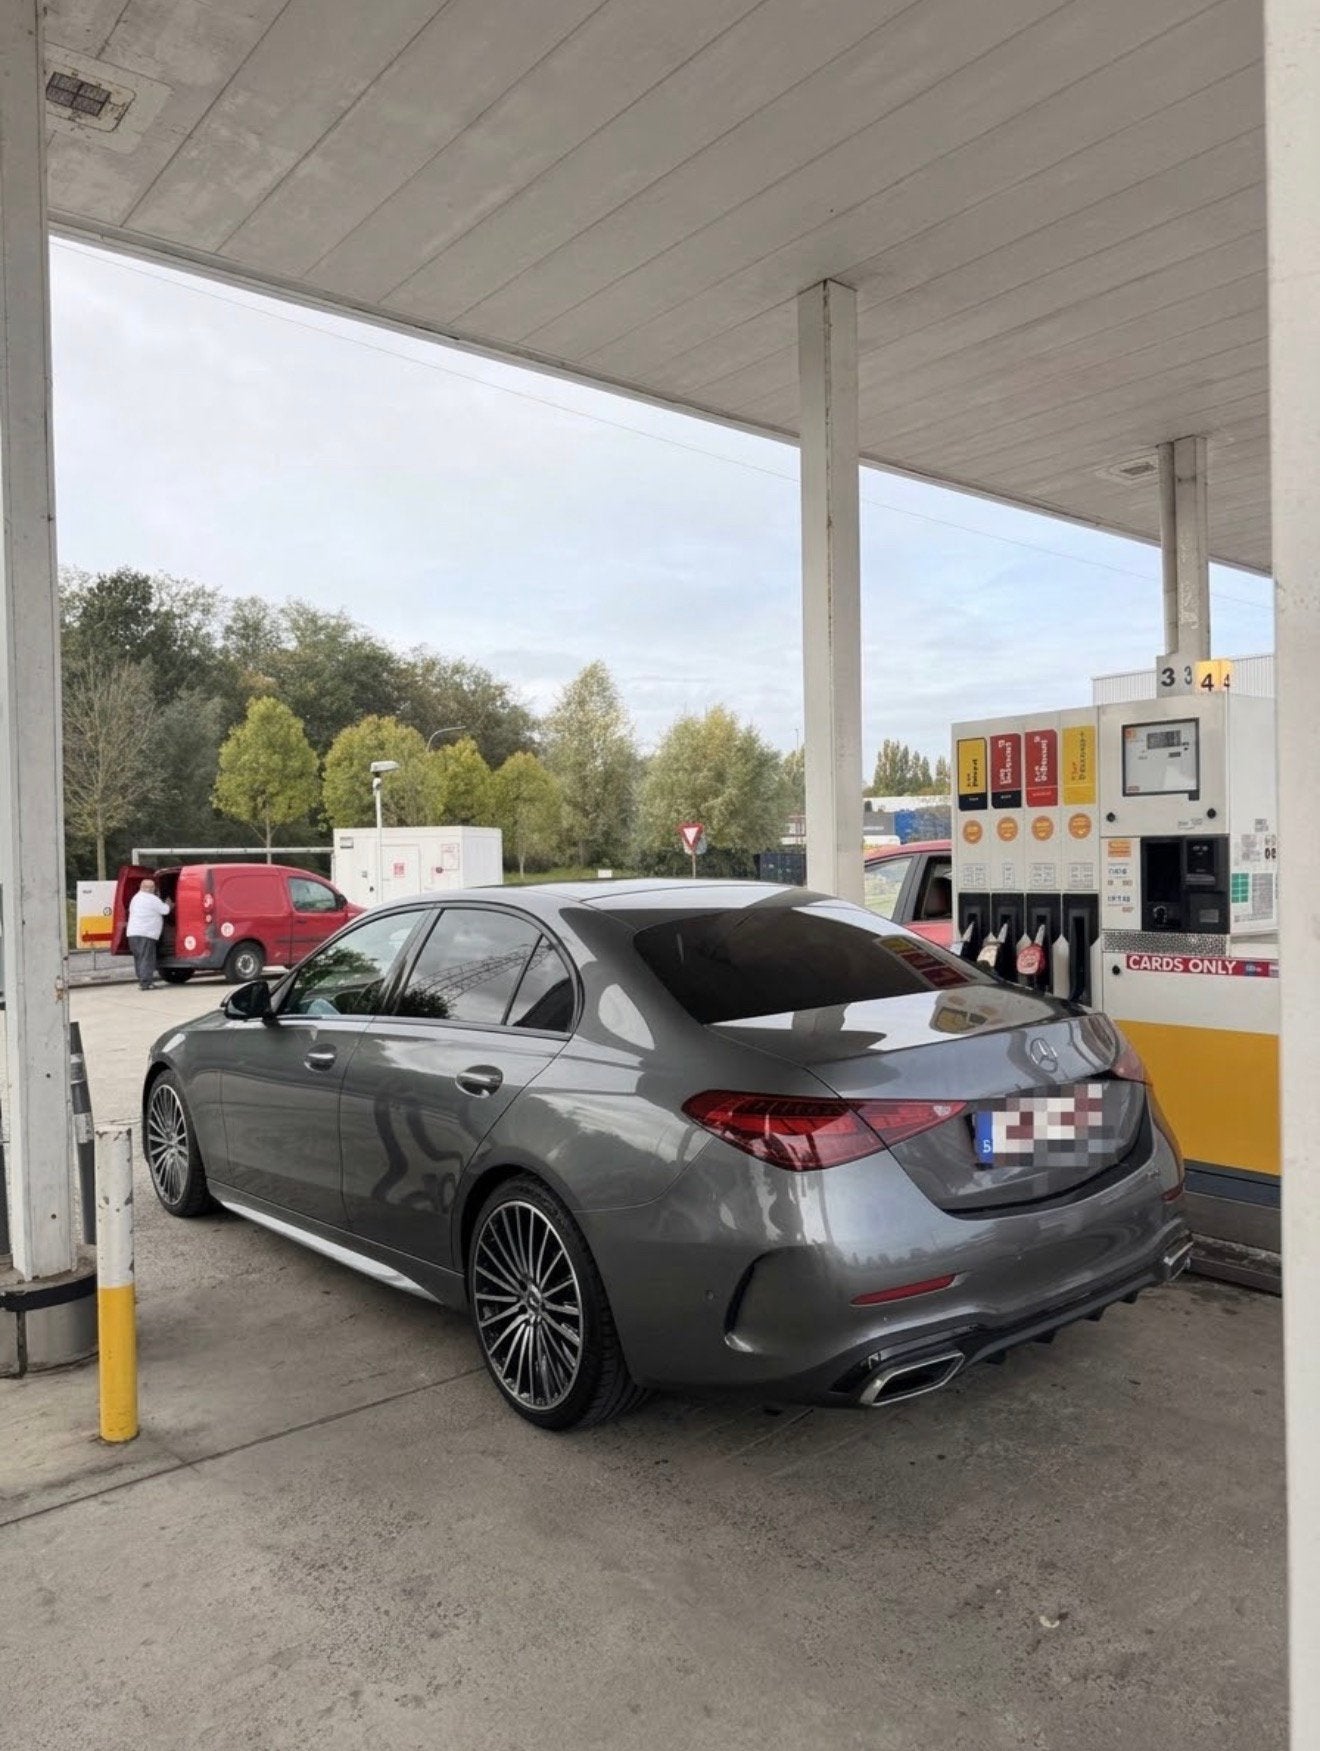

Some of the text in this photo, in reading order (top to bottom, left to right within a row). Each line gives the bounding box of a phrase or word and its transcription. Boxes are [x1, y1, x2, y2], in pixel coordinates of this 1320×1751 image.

[1161, 667, 1175, 687] 3
[1184, 665, 1193, 685] 3
[1201, 673, 1214, 692] 4
[1129, 955, 1183, 971] CARDS
[1188, 959, 1236, 974] ONLY
